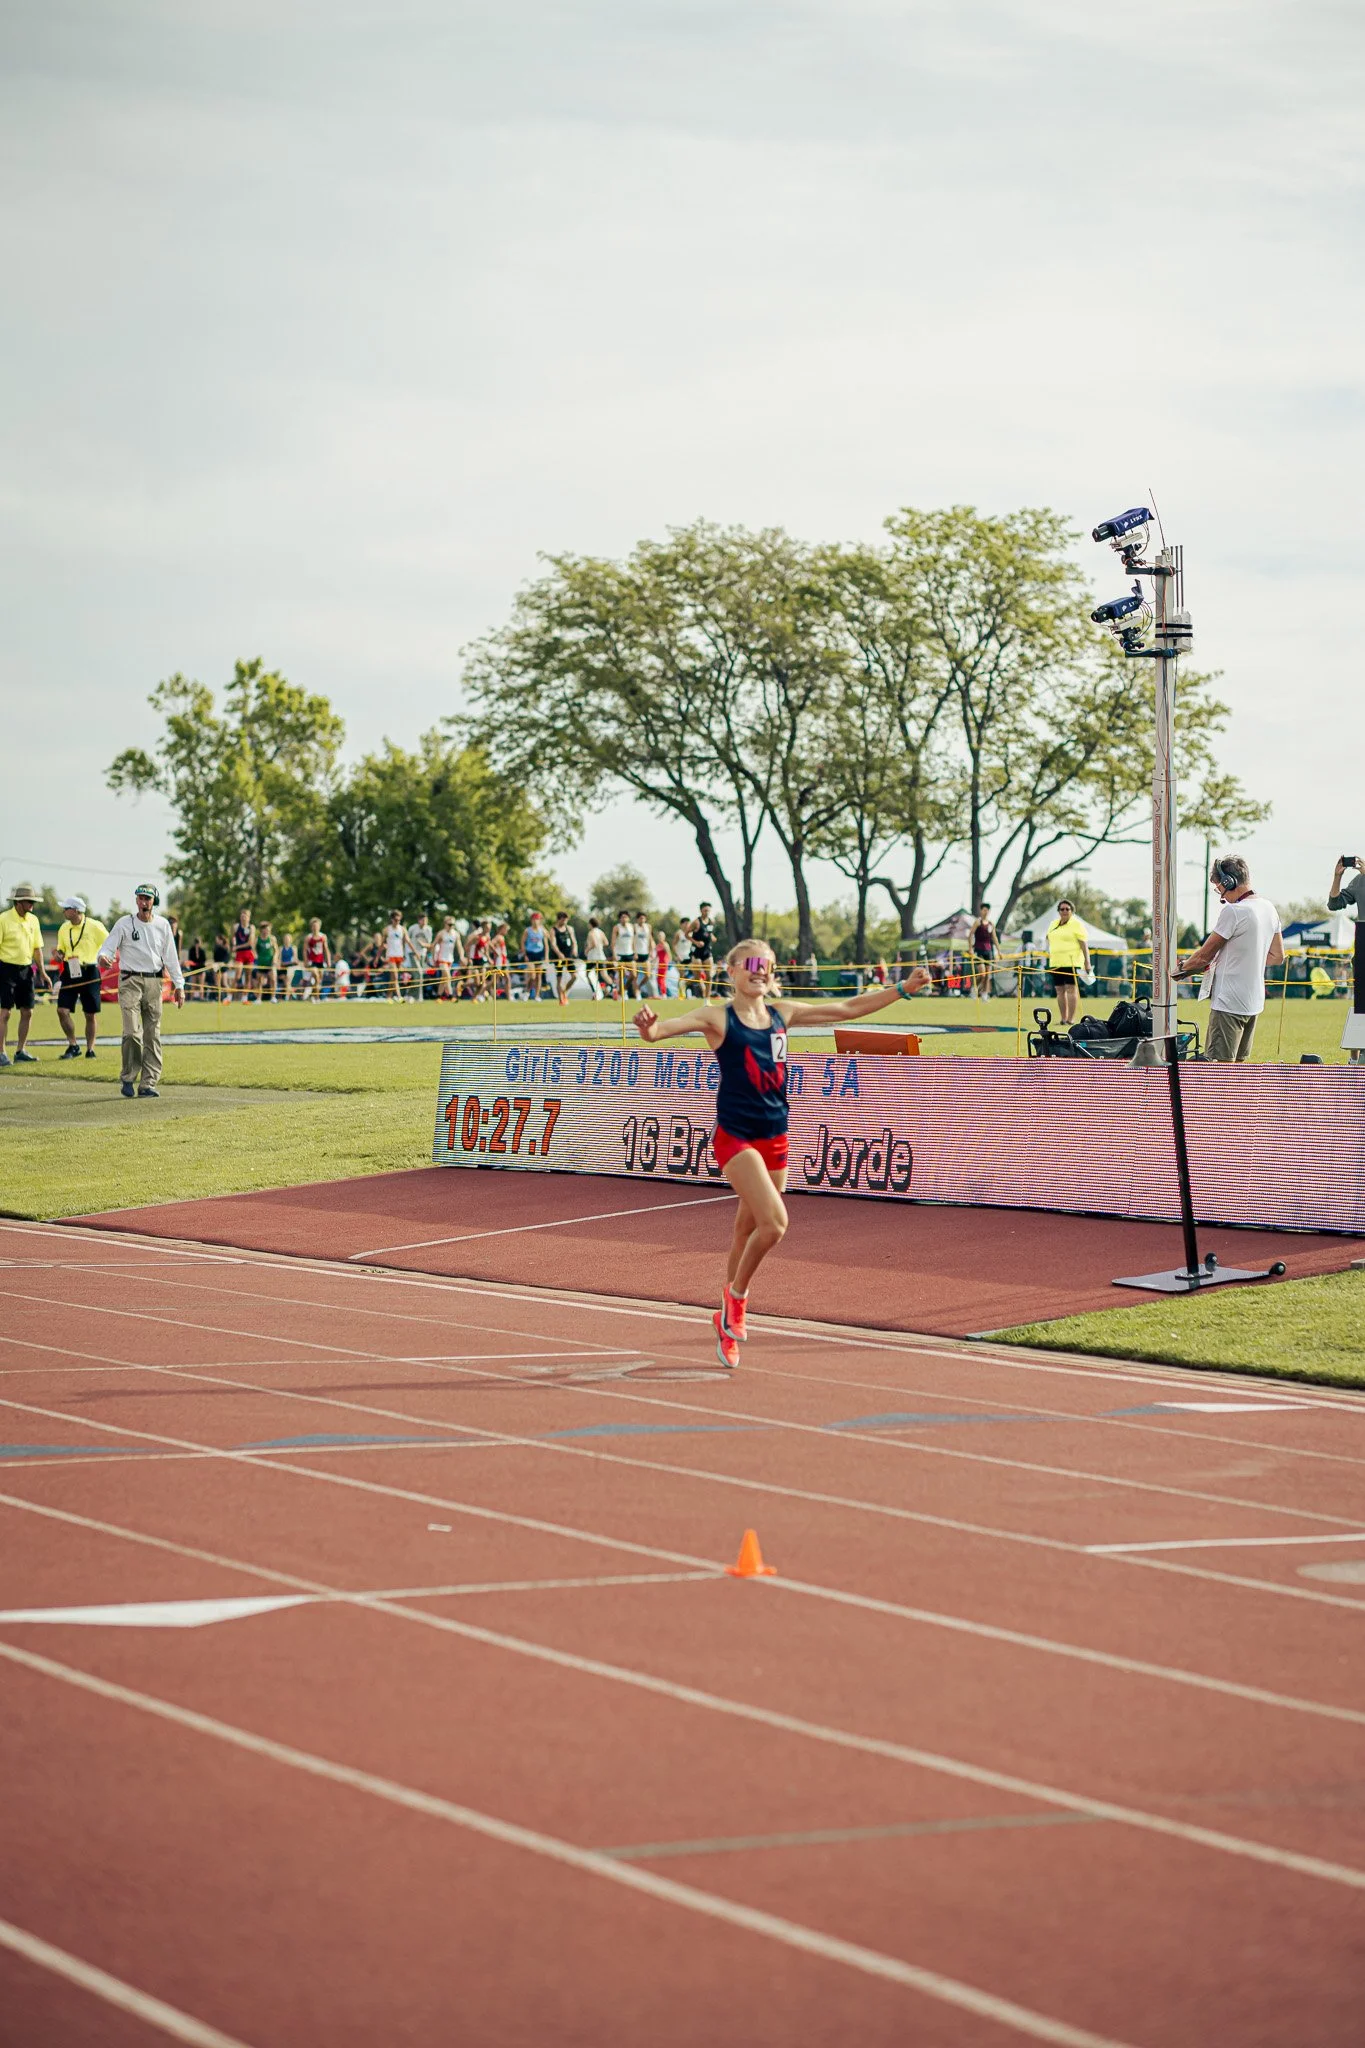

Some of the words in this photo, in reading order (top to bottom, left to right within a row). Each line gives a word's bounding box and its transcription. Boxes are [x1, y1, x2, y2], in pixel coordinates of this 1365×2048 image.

[504, 1047, 562, 1083] Girls
[575, 1049, 640, 1086] 3200
[653, 1051, 721, 1090] Mete
[821, 1057, 860, 1098] 5A
[775, 1036, 785, 1060] 2
[444, 1094, 562, 1156] 10:27.7
[622, 1115, 660, 1171] 16
[803, 1124, 913, 1192] Jorde
